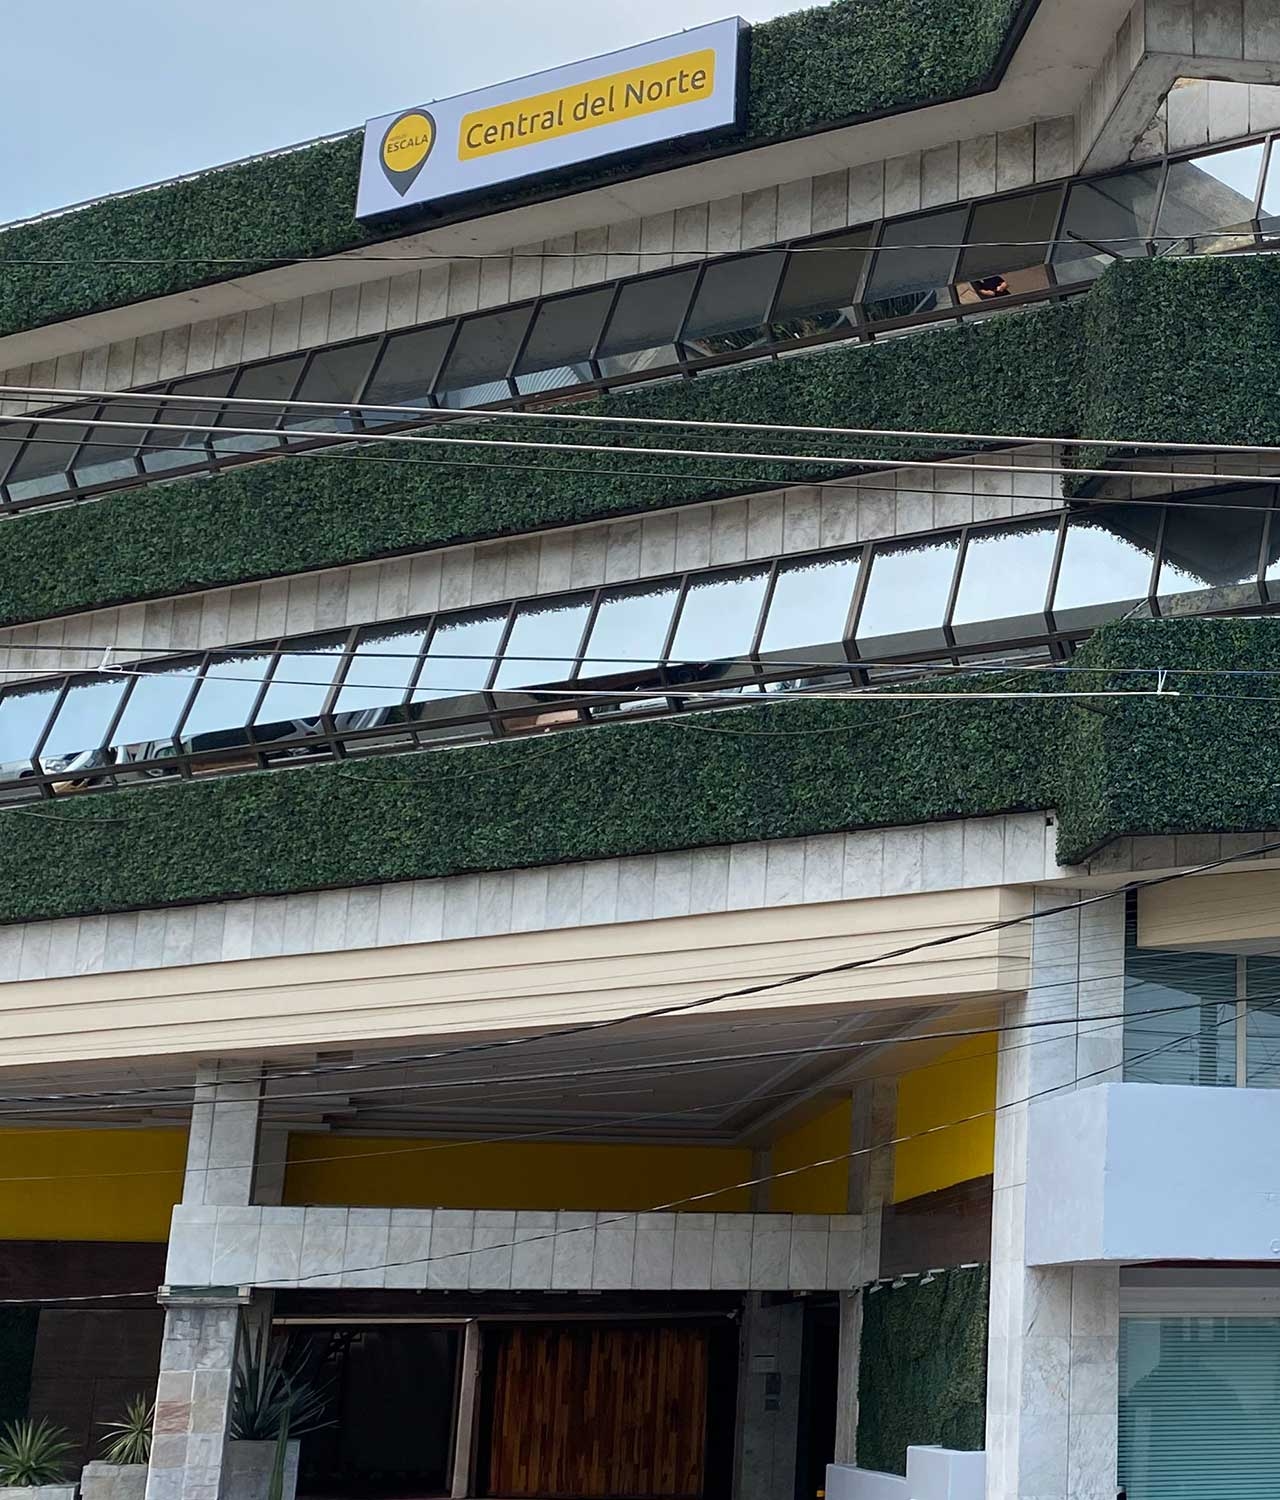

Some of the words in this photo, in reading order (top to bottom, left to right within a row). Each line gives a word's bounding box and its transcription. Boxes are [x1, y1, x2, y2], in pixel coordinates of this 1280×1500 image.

[466, 100, 563, 149] Central
[572, 86, 615, 121] del
[624, 69, 706, 108] Norte
[387, 134, 429, 154] ESCALA
